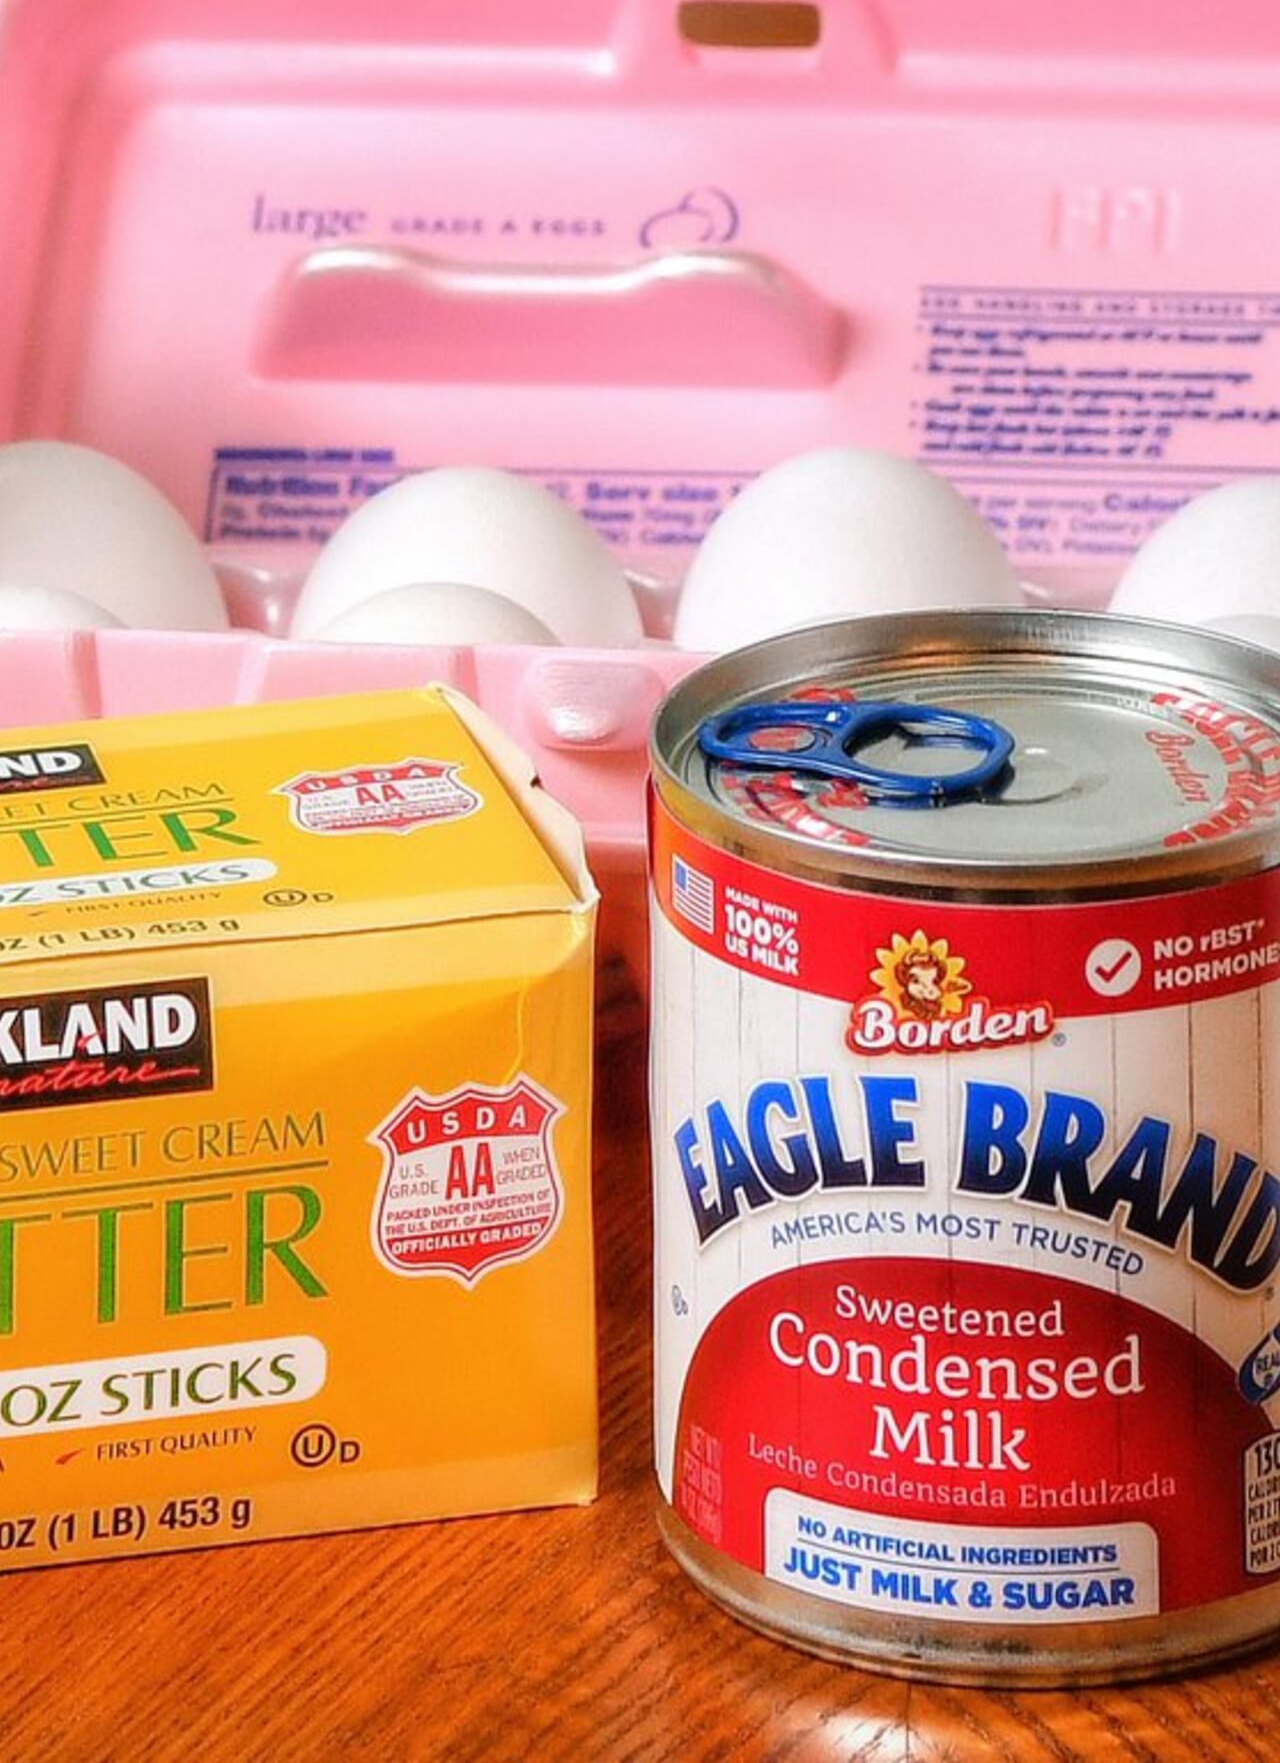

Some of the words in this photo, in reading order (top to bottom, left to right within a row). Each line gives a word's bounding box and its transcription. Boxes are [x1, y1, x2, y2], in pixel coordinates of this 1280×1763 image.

[252, 195, 367, 239] large
[391, 218, 483, 236] GRADE
[501, 218, 517, 236] A
[531, 219, 606, 236] EGGS
[67, 782, 225, 812] CREAM
[355, 784, 406, 806] AA
[56, 864, 252, 898] STICKS
[725, 886, 760, 912] MADE
[761, 900, 799, 923] WITH
[38, 932, 64, 949] (1
[80, 924, 135, 943] LB)
[146, 917, 207, 936] 453
[220, 918, 240, 934] g
[724, 904, 800, 955] 100%
[1153, 936, 1194, 960] NO
[724, 932, 749, 958] US
[751, 943, 800, 976] MILK
[853, 996, 1050, 1050] Borden
[162, 1111, 326, 1164] CREAM
[406, 1105, 527, 1143] USDA
[399, 1164, 429, 1180] U.S.
[445, 1142, 495, 1200] AA
[495, 1163, 547, 1186] GRADED
[501, 1146, 541, 1165] WHEN
[673, 1074, 926, 1248] EAGLE
[386, 1208, 431, 1222] PACKED
[432, 1203, 470, 1217] UNDER
[472, 1193, 535, 1211] INSPECTION
[537, 1189, 551, 1200] OF
[389, 1180, 440, 1200] GRADE
[385, 1225, 406, 1236] THE
[407, 1221, 428, 1234] U.S.
[430, 1216, 461, 1230] DEPT.
[463, 1214, 478, 1226] OF
[479, 1203, 553, 1224] AGRICULTURE
[391, 1232, 477, 1255] OFFICIALLY
[480, 1222, 543, 1244] GRADED
[771, 1211, 905, 1249] AMERICA'S
[917, 1215, 1001, 1240] MOST
[1011, 1224, 1145, 1276] TRUSTED
[835, 1284, 1065, 1340] Sweetened
[769, 1311, 1146, 1403] Condensed
[0, 1379, 82, 1428] OZ
[99, 1353, 297, 1417] STICKS
[96, 1438, 155, 1463] FIRST
[159, 1425, 259, 1457] QUALITY
[339, 1440, 360, 1464] D
[869, 1405, 1032, 1473] Milk
[748, 1432, 818, 1479] Leche
[827, 1460, 1007, 1508] Condensada
[1020, 1472, 1177, 1509] Endulzada
[48, 1511, 78, 1553] (1
[90, 1503, 148, 1542] LB)
[158, 1494, 221, 1531] 453
[230, 1495, 252, 1528] g
[797, 1514, 827, 1538] NO
[833, 1522, 956, 1563] ARTIFICIAL
[961, 1543, 1117, 1566] INGREDIENTS
[783, 1546, 861, 1591] JUST
[871, 1568, 958, 1607] MILK
[968, 1580, 992, 1608] &
[1002, 1577, 1136, 1609] SUGAR
